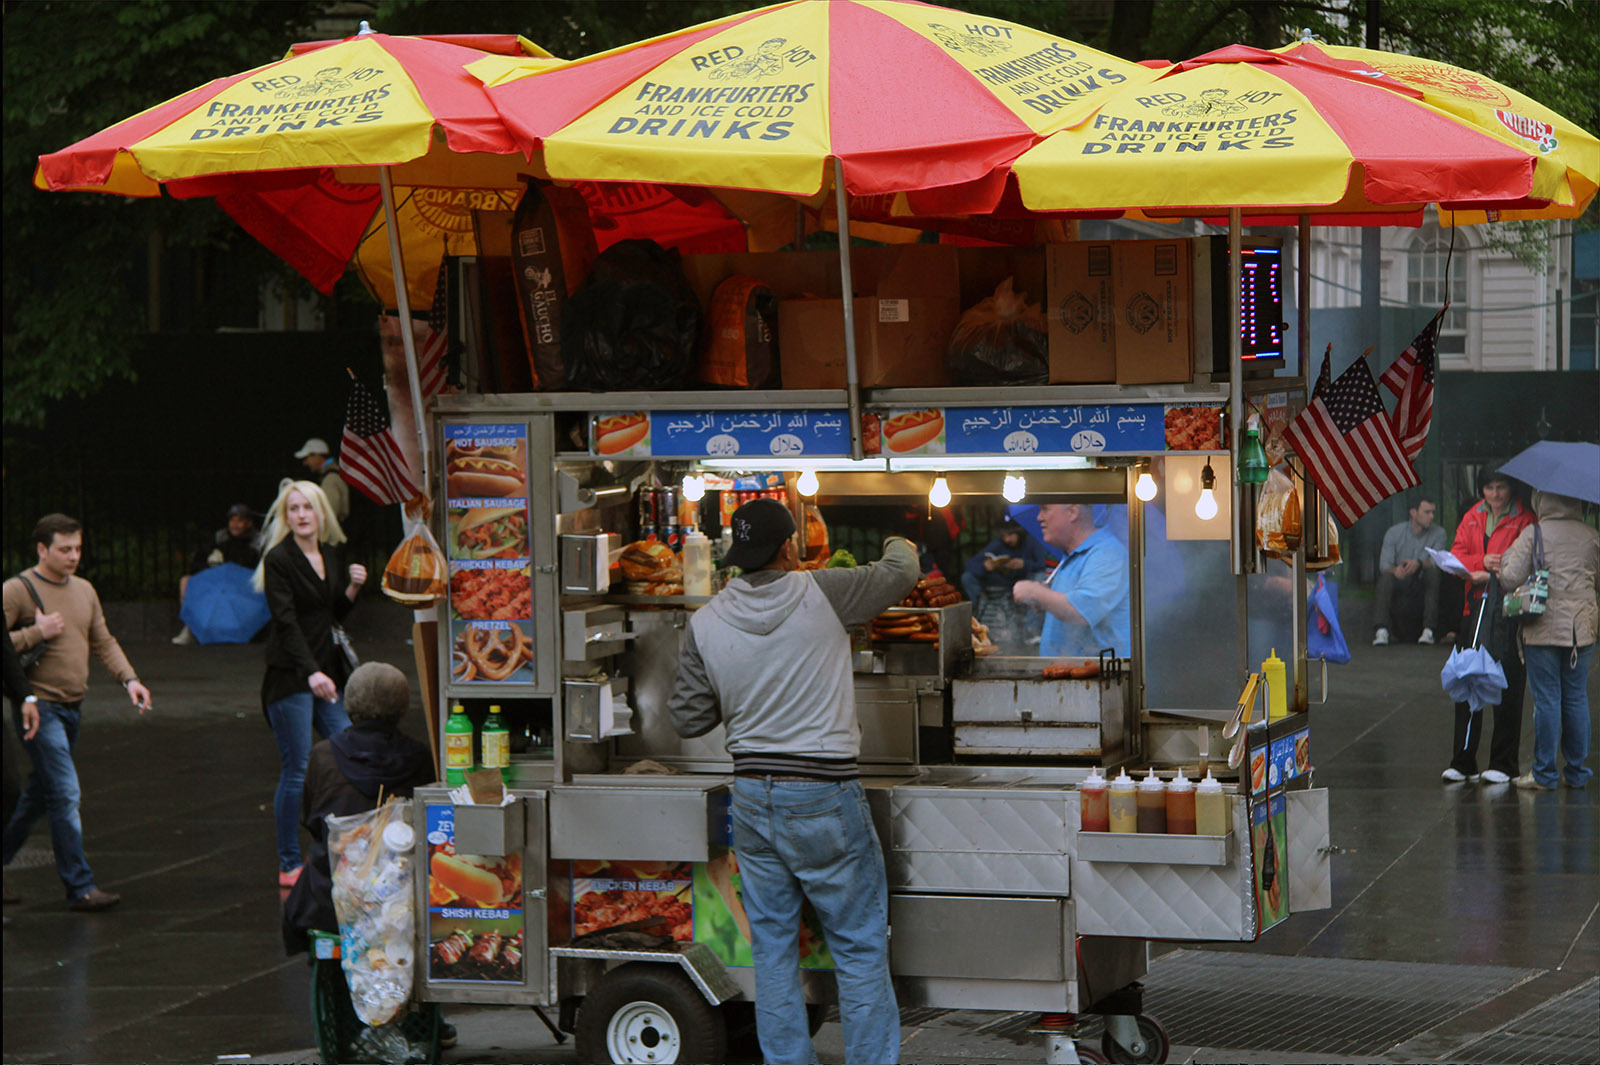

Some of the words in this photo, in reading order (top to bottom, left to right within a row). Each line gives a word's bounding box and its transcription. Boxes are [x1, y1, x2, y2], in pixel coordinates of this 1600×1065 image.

[965, 24, 1014, 40] HOT
[691, 45, 745, 72] RED
[782, 44, 817, 68] HOT
[973, 42, 1077, 86] FRANKFURTERS
[251, 75, 302, 93] RED
[345, 68, 385, 82] HOT
[1008, 81, 1040, 97] AND
[1034, 73, 1063, 87] ICE
[1055, 61, 1093, 79] COLD
[207, 83, 392, 118] FRANKFURTERS
[636, 81, 816, 104] FRANKFURTERS
[1022, 68, 1127, 115] DRINKS
[1135, 92, 1187, 109] RED
[1234, 90, 1283, 105] HOT
[211, 116, 263, 127] AND
[272, 112, 309, 122] ICE
[318, 102, 380, 118] COLD
[634, 104, 685, 116] AND
[691, 105, 730, 118] ICE
[734, 105, 795, 118] COLD
[1093, 109, 1298, 133] FRANKFURTERS
[190, 110, 385, 141] DRINKS
[607, 116, 796, 141] DRINKS
[1101, 132, 1156, 141] AND
[1168, 133, 1206, 141] ICE
[1217, 127, 1286, 139] COLD
[1081, 136, 1295, 155] DRINKS
[534, 291, 553, 343] GAUCHO
[454, 439, 473, 448] HOT
[474, 438, 517, 448] SAUSAGE
[448, 499, 482, 509] ITALIAN
[484, 499, 527, 509] SAUSAGE
[495, 560, 526, 570] KEBAB
[472, 621, 512, 631] PRETZEL
[590, 880, 636, 891] CHICKEN
[638, 881, 675, 891] KEBAB
[441, 908, 472, 919] SHISH
[474, 909, 510, 919] KEBAB
